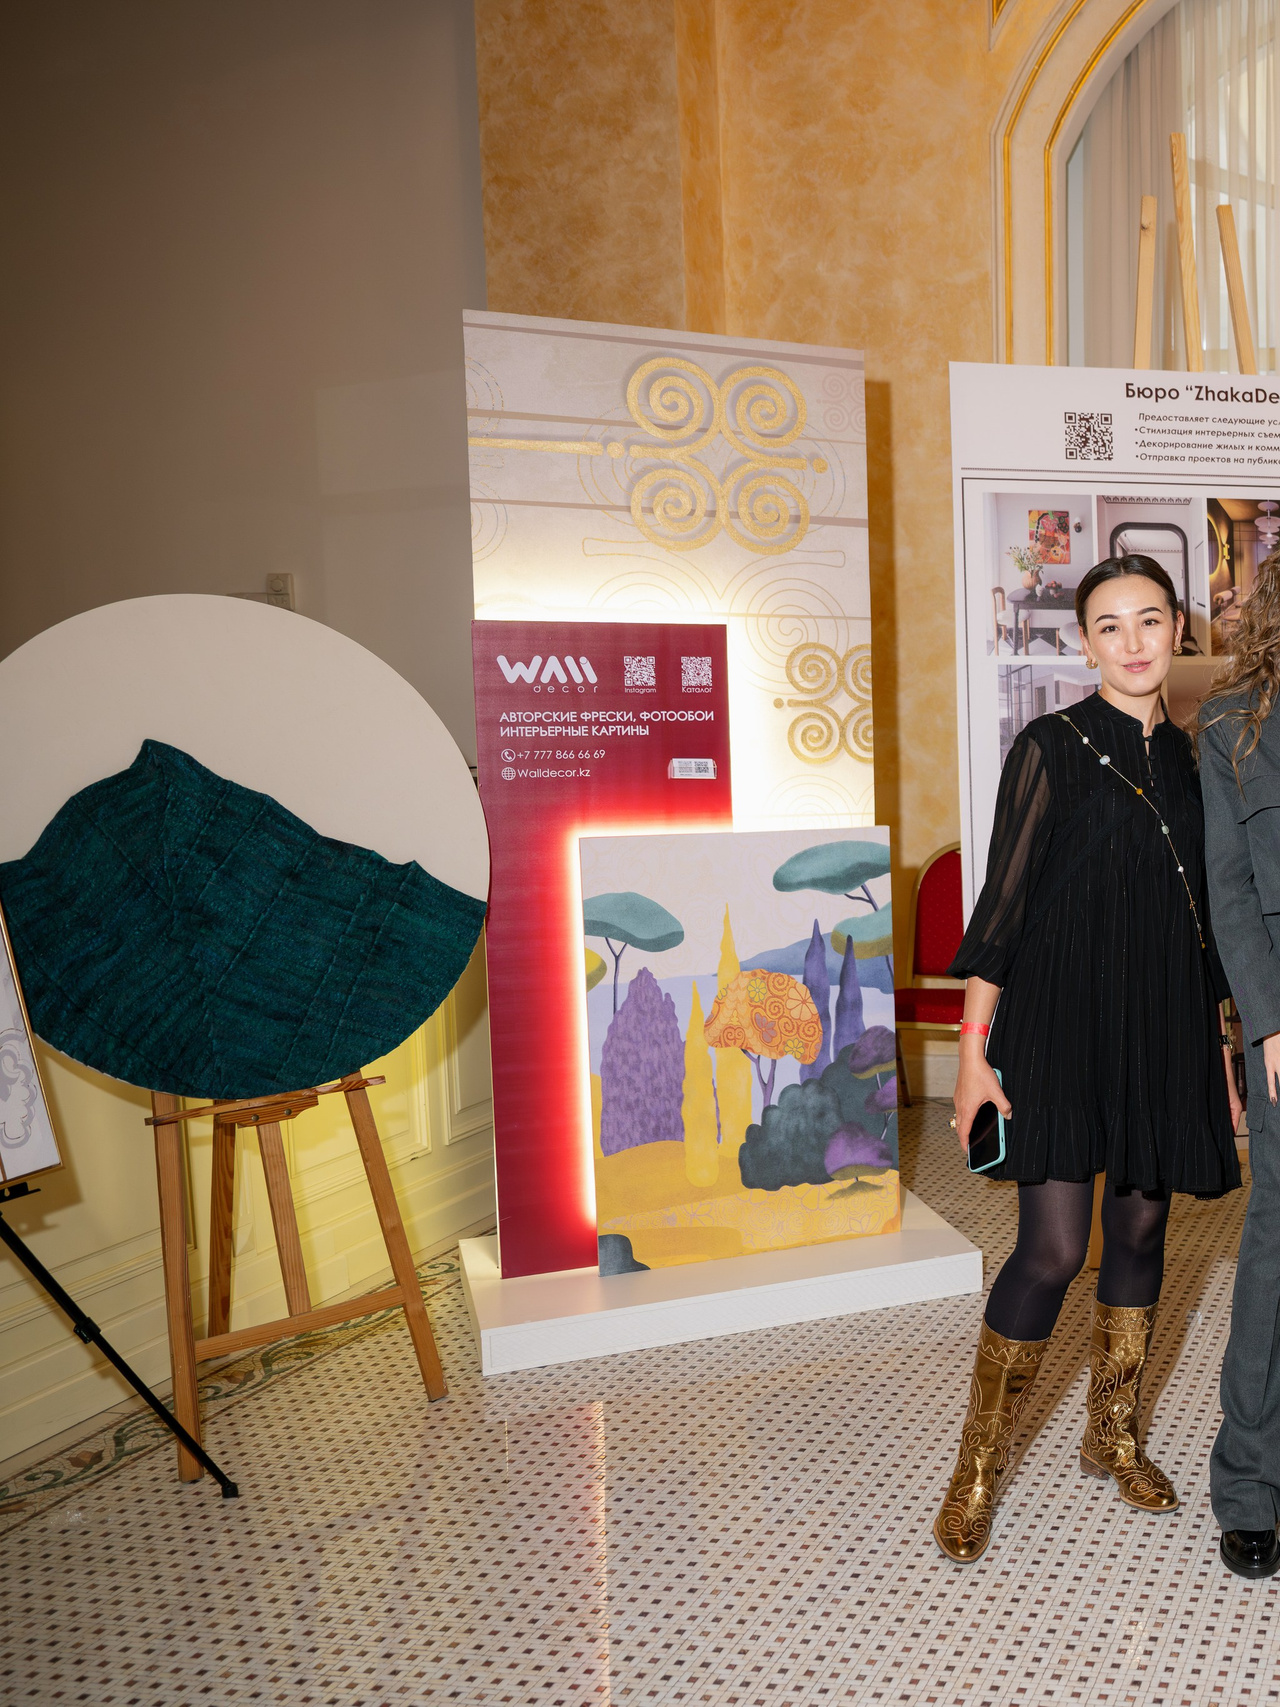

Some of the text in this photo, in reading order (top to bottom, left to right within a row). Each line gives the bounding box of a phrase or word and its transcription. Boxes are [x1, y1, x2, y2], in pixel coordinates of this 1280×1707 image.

[1125, 382, 1180, 403] Бюро
[1138, 412, 1209, 423] Предоставляет
[1211, 416, 1265, 425] следующие
[1195, 429, 1255, 438] интерьерных
[1216, 443, 1245, 451] жилых
[1187, 455, 1232, 464] проектов
[533, 684, 598, 693] decor
[624, 687, 657, 695] Instagram
[681, 686, 713, 694] Каталог
[499, 709, 715, 724] АВТОРСКИЕ ФРЕСКИ, ФОТООБОИ
[500, 725, 650, 738] ИНТЕРЬЕРНЫЕ КАРТИНЫ
[517, 749, 606, 760] +7 777 866 66 69
[517, 766, 591, 778] Walldecor.kz
